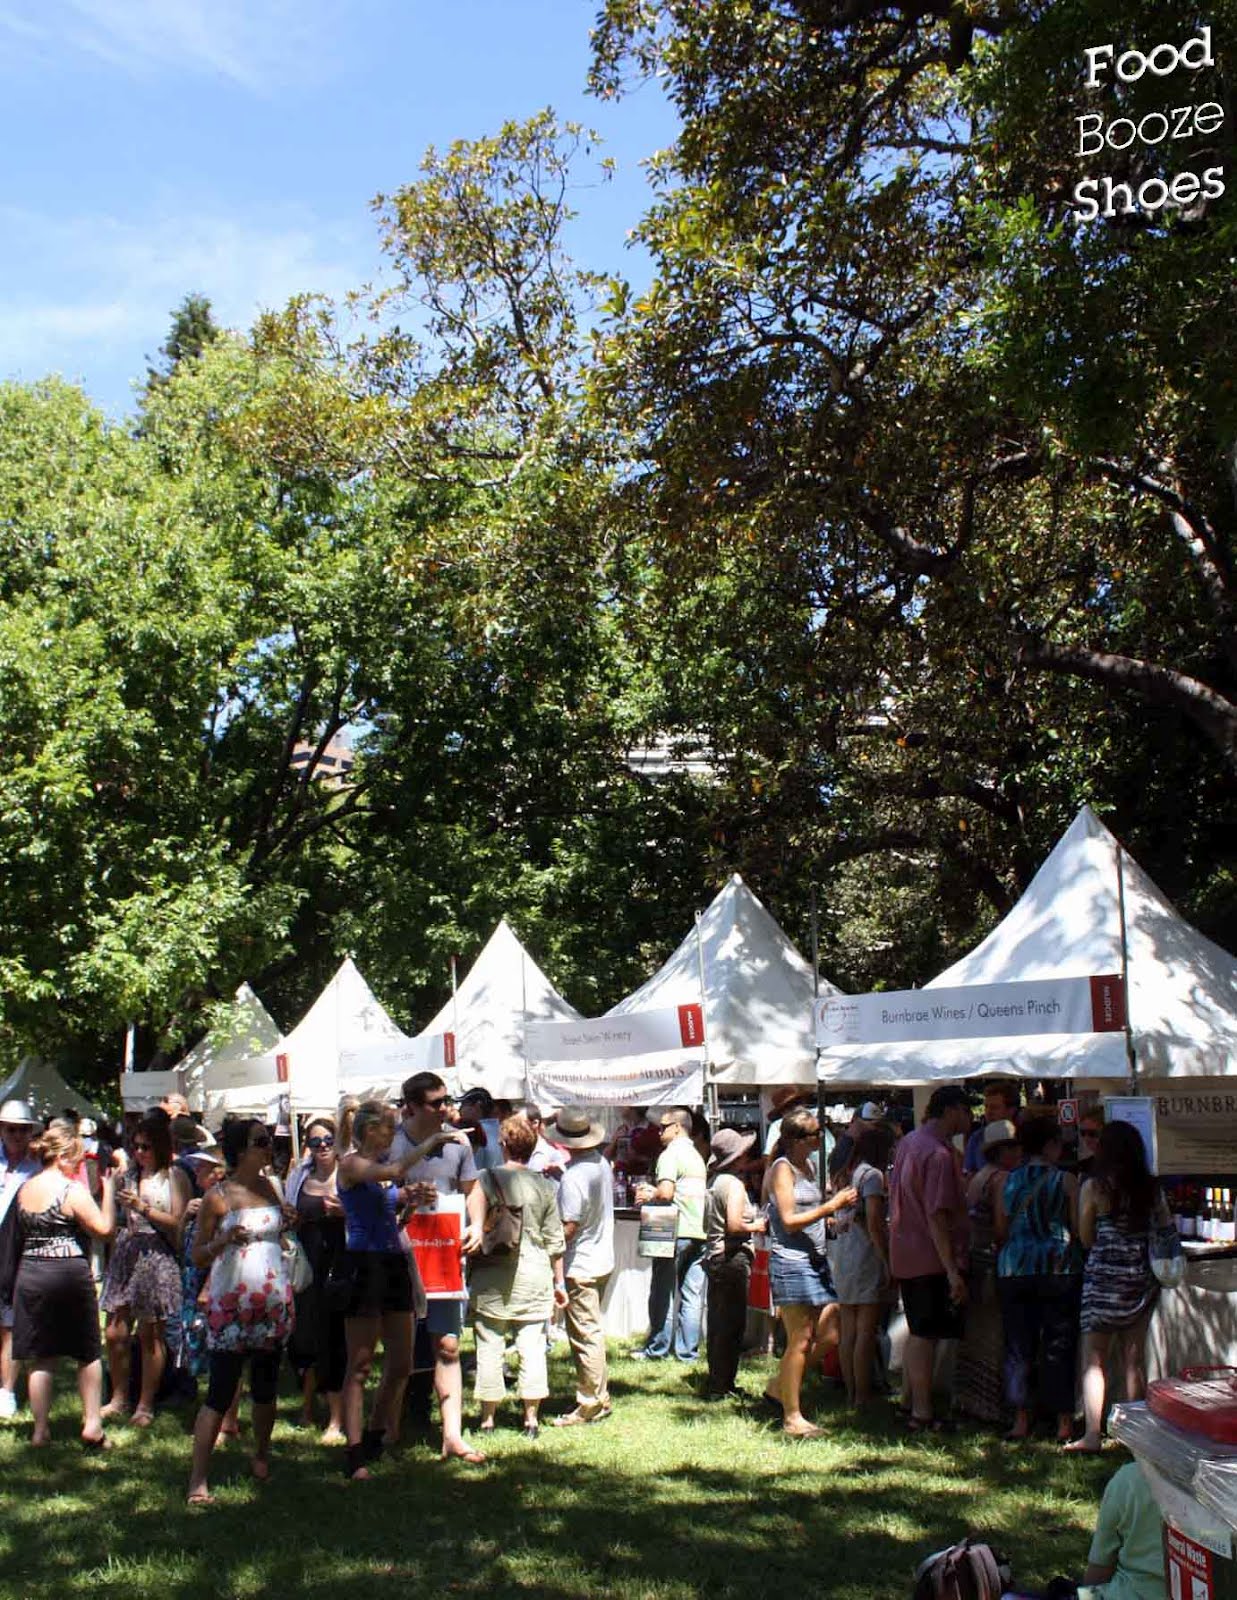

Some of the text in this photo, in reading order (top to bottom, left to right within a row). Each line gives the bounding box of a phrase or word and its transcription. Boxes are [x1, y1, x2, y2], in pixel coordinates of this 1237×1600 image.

[881, 999, 1061, 1024] Burnbrae Wines / Queens Pinch
[1158, 1096, 1237, 1116] BURNBR
